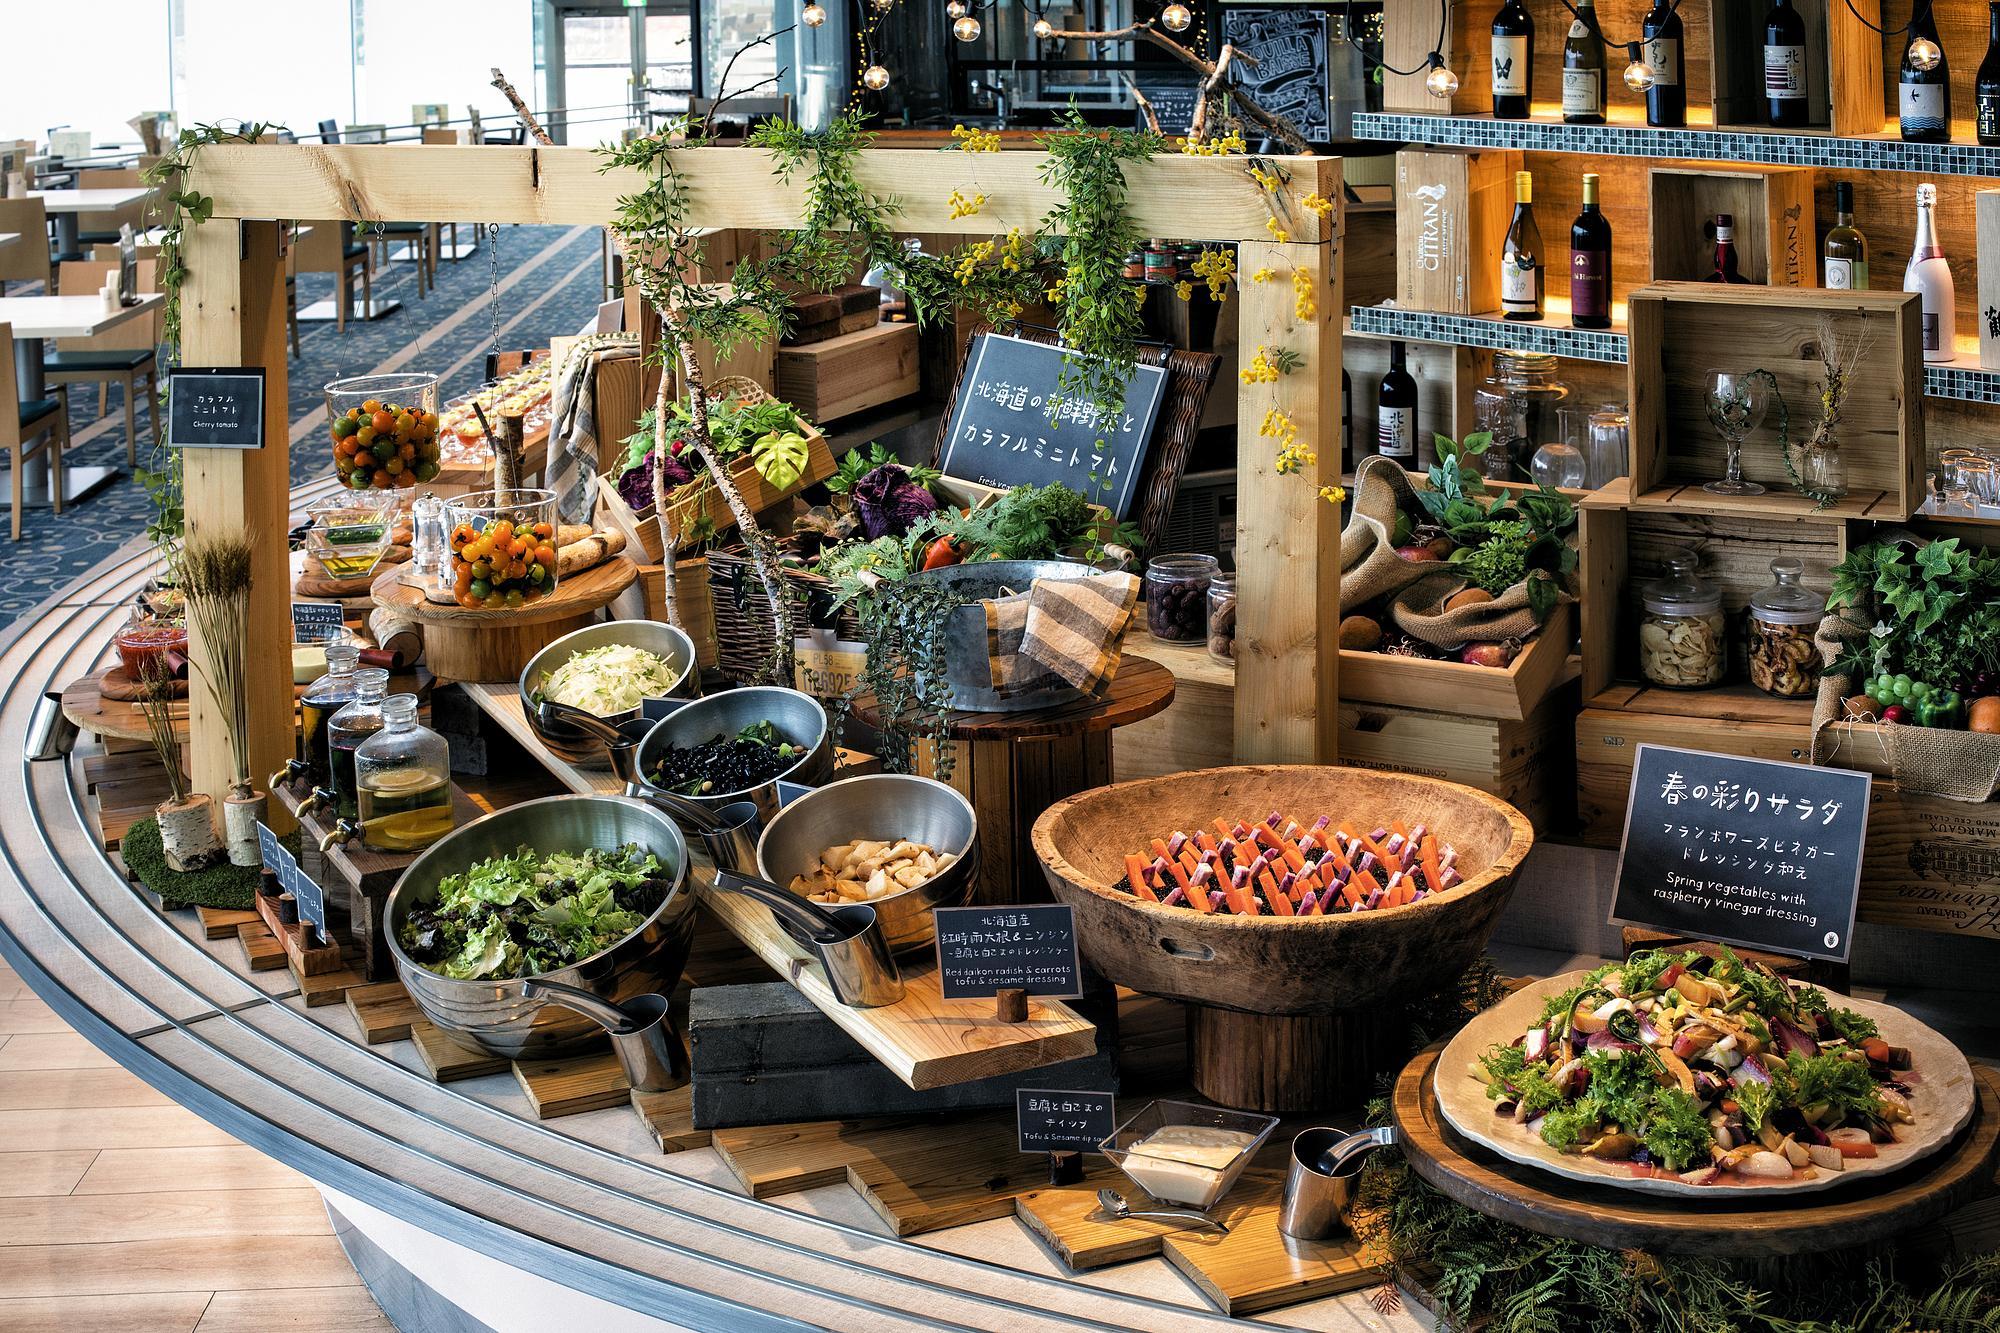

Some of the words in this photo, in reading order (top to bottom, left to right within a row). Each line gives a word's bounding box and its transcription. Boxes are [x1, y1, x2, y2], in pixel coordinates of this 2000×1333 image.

[1423, 202, 1439, 271] CITRAN
[1787, 226, 1799, 287] ITRAN
[198, 395, 234, 403] カラフル
[193, 405, 237, 415] ミニトマト
[193, 421, 215, 429] Cherry
[964, 423, 1118, 477] カラフルミニトマト
[978, 475, 997, 487] Fresh
[1401, 765, 1447, 778] CONTIENE
[1660, 770, 1844, 825] 春の彩りサラダ
[1954, 817, 1971, 825] CRU
[1929, 822, 1997, 838] MARGAUX
[1683, 847, 1808, 880] ドレッシング和え
[1666, 871, 1704, 892] Spring
[1707, 880, 1777, 901] vegetables
[1780, 892, 1806, 906] with
[1653, 888, 1711, 909] raspberry
[1715, 897, 1763, 916] vinegar
[1765, 905, 1817, 927] dressing
[981, 914, 1031, 927] 北海道産
[945, 968, 962, 977] Red
[963, 967, 993, 976] daikon
[995, 966, 1023, 975] radish
[1026, 966, 1032, 974] &
[1034, 966, 1071, 974] carrots
[955, 976, 976, 986] tofu
[978, 977, 985, 985] &
[988, 976, 1024, 985] sesame
[1026, 975, 1066, 985] dressing
[1024, 1132, 1042, 1140] Tofu
[1051, 1133, 1081, 1141] Sesame
[1081, 1134, 1091, 1143] dip
